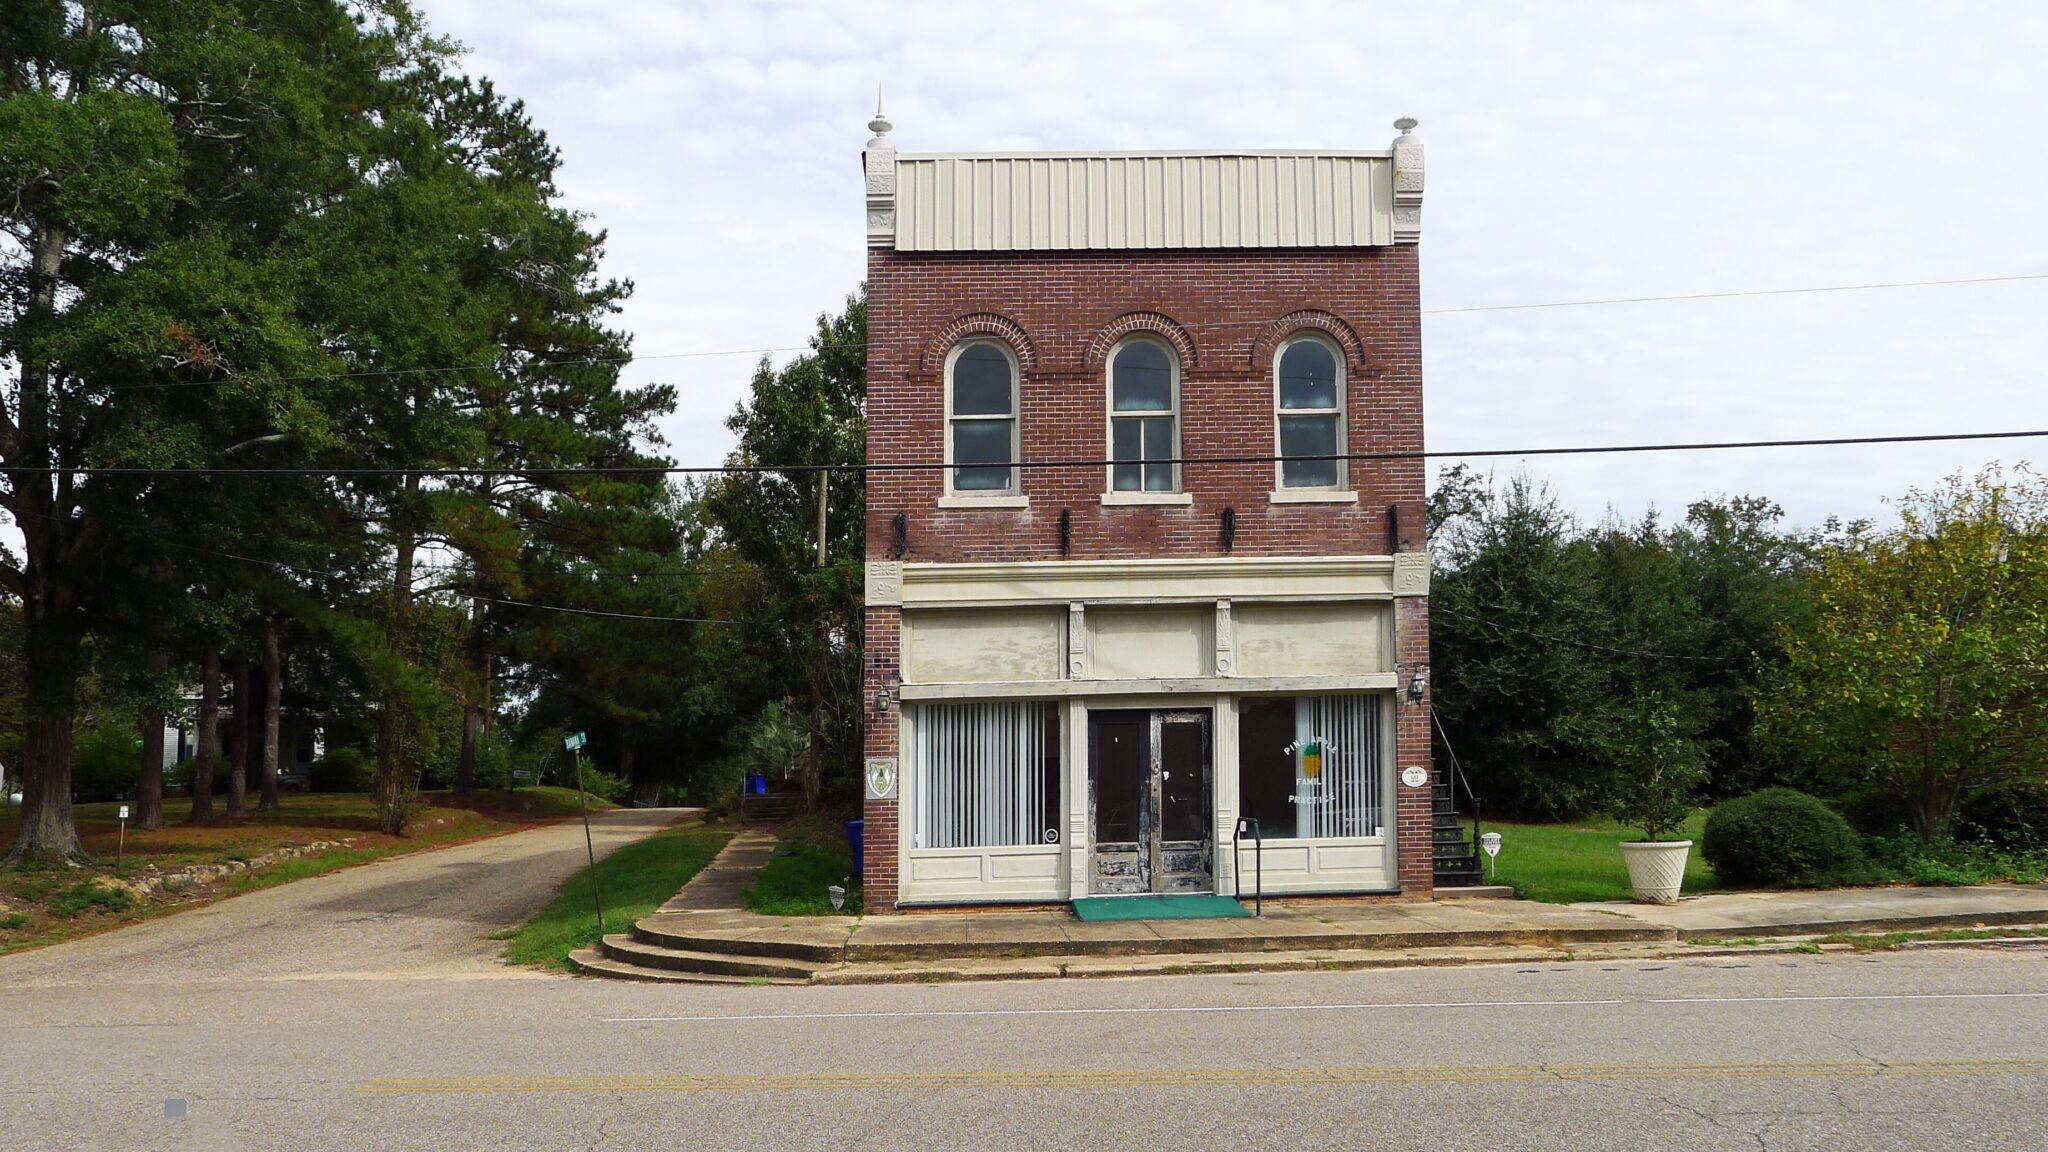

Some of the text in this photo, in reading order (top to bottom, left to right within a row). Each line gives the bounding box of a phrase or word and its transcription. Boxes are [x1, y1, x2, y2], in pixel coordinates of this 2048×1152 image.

[1283, 735, 1338, 756] PINE APPLE
[1288, 792, 1336, 804] PRACTICE
